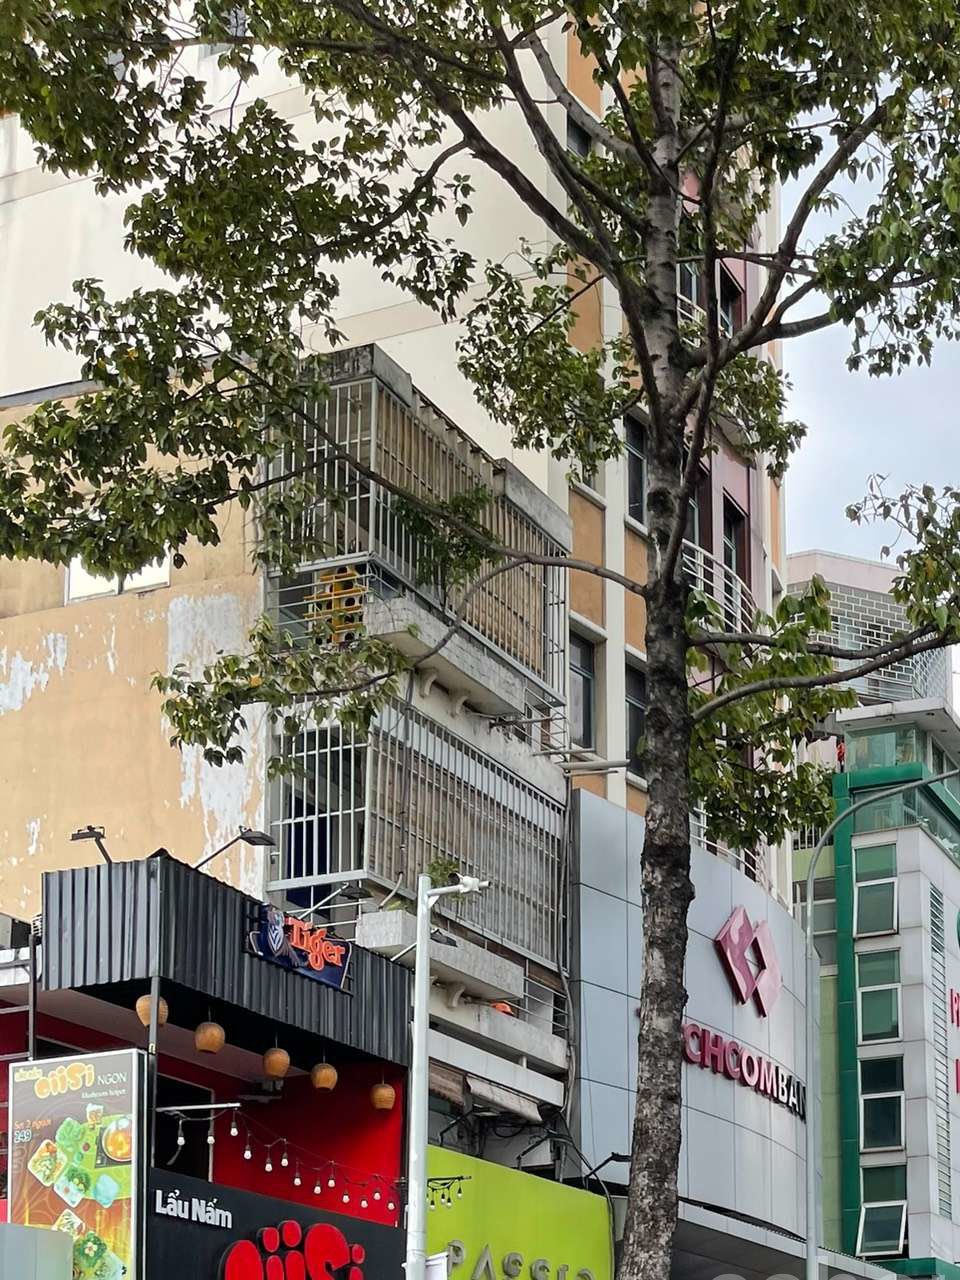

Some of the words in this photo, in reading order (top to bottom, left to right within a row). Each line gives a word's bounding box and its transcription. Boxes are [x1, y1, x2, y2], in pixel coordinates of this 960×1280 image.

[285, 917, 346, 971] Tiger
[97, 1072, 128, 1086] NGON
[155, 1189, 189, 1220] Lẩu
[191, 1198, 233, 1229] Nấm
